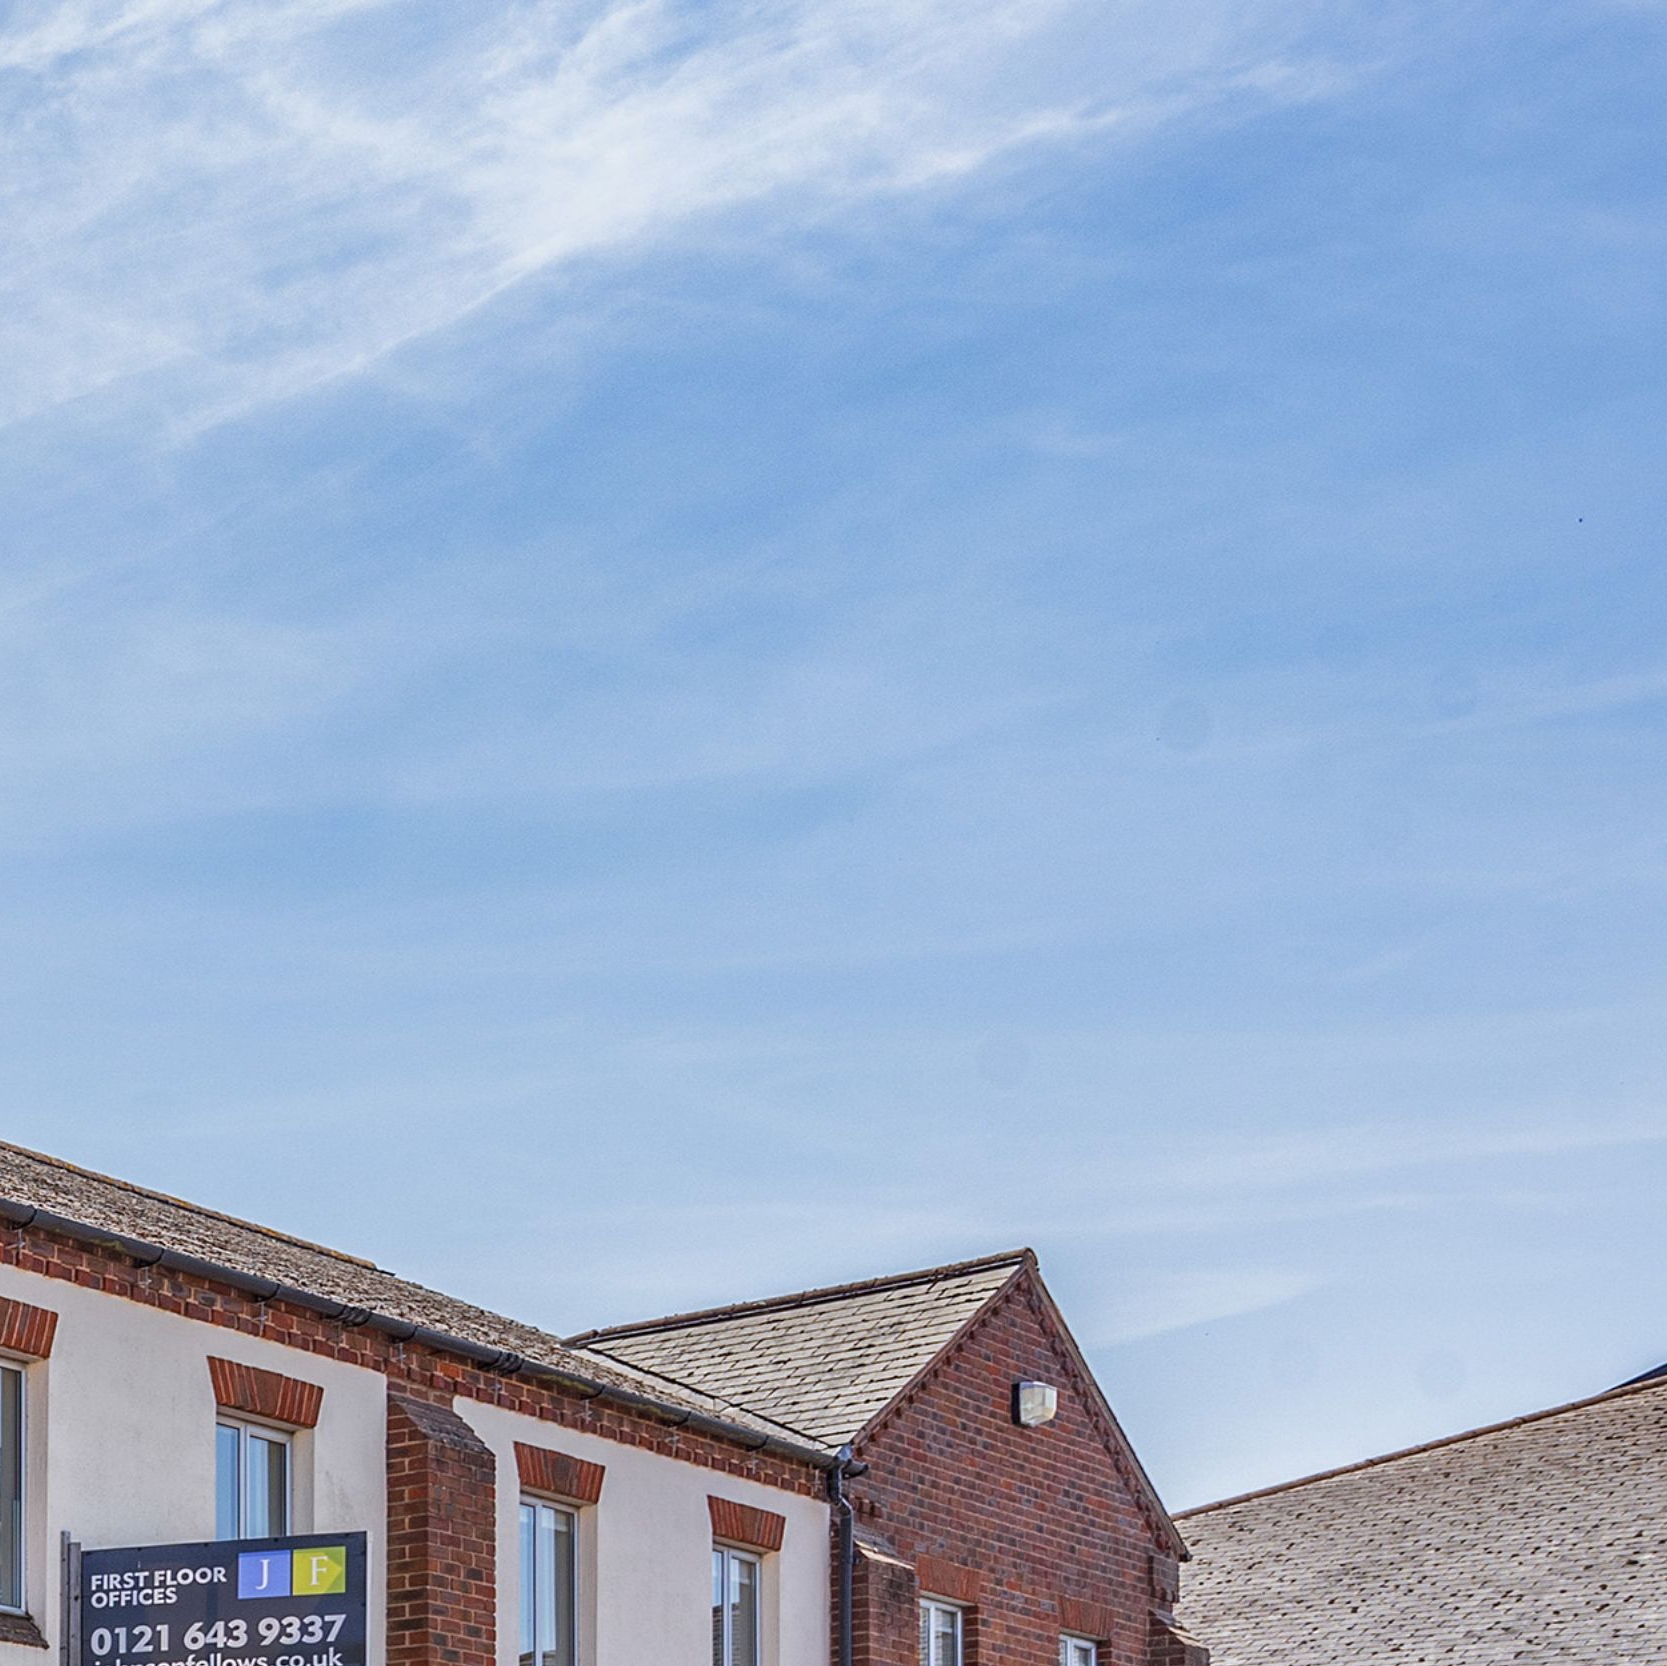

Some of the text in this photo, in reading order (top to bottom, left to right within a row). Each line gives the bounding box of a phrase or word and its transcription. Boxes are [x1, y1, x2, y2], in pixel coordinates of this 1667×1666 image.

[90, 1567, 227, 1590] FIRST FLOOR
[255, 1559, 271, 1590] J
[310, 1555, 328, 1586] F
[90, 1587, 178, 1608] OFFICES
[90, 1614, 347, 1656] 0121 643 9337
